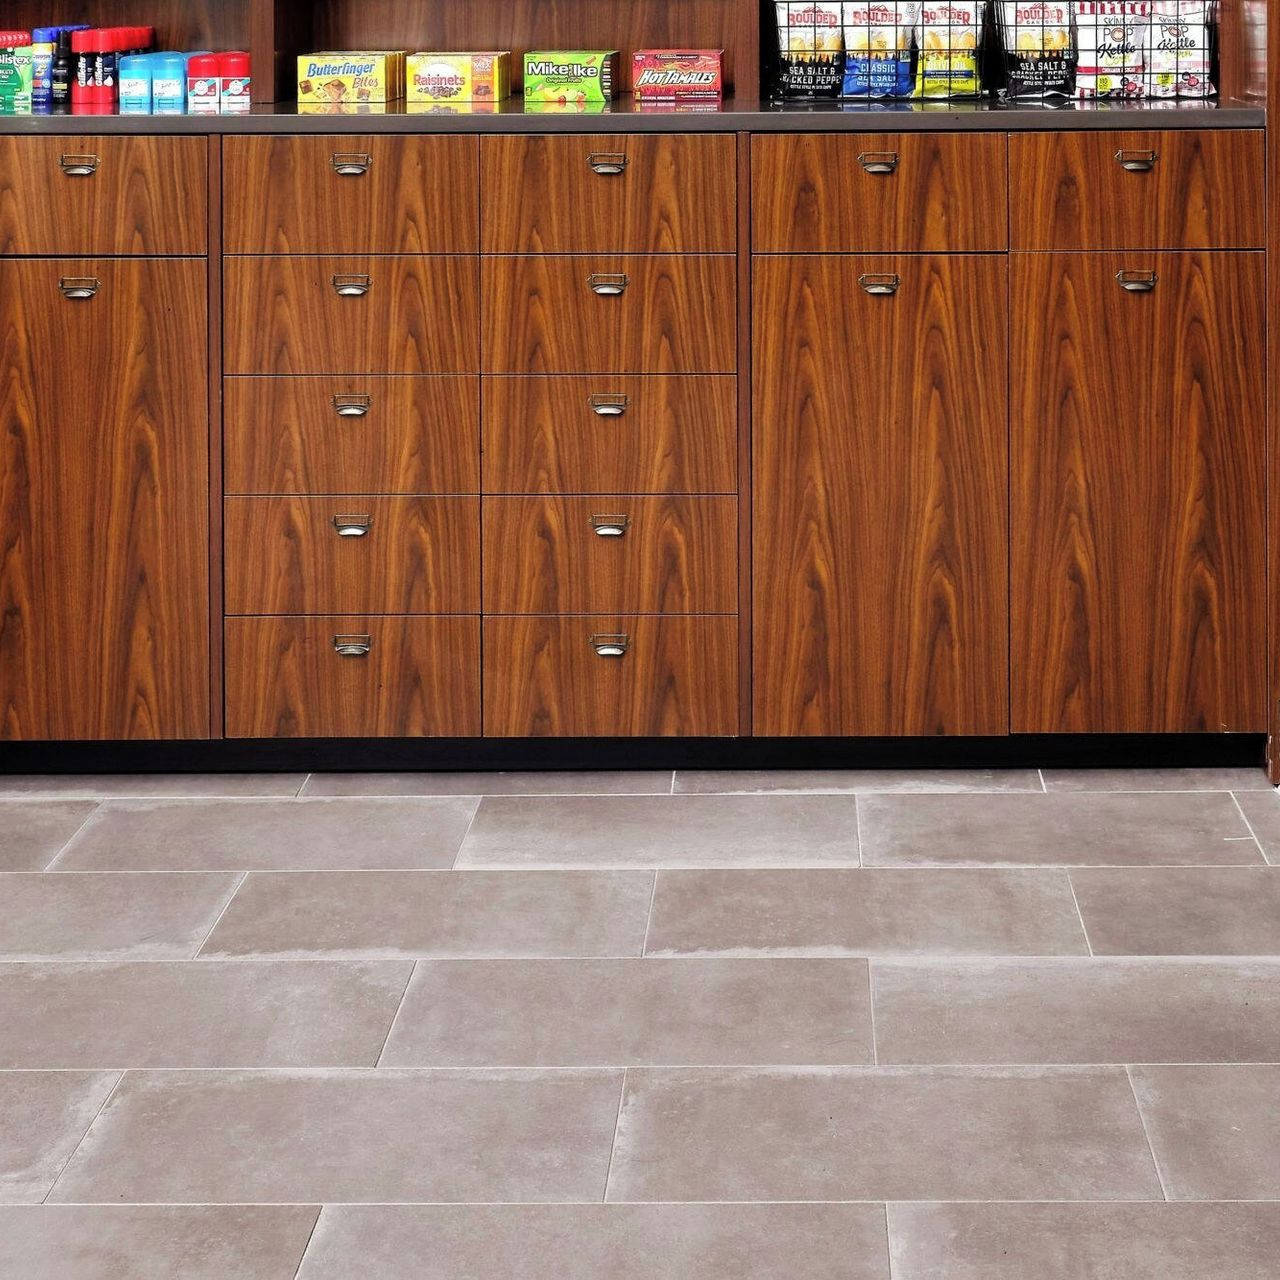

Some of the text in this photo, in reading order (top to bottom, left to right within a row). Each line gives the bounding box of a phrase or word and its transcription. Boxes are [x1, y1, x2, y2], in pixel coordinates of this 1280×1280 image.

[787, 10, 838, 28] BOULDER
[852, 10, 902, 24] BOULDER
[921, 10, 970, 25] BOULDER
[1016, 8, 1063, 23] BOULDER
[1097, 43, 1137, 59] Kettle
[77, 56, 87, 87] Gillette
[94, 56, 104, 87] Gillette
[307, 62, 375, 78] Butterfinger
[527, 61, 598, 77] Mike Ike
[1020, 61, 1035, 70] SEA
[1038, 61, 1059, 70] SALT
[352, 77, 379, 89] Bites
[413, 73, 466, 86] Raisinets
[636, 69, 717, 87] HOT TAMALES
